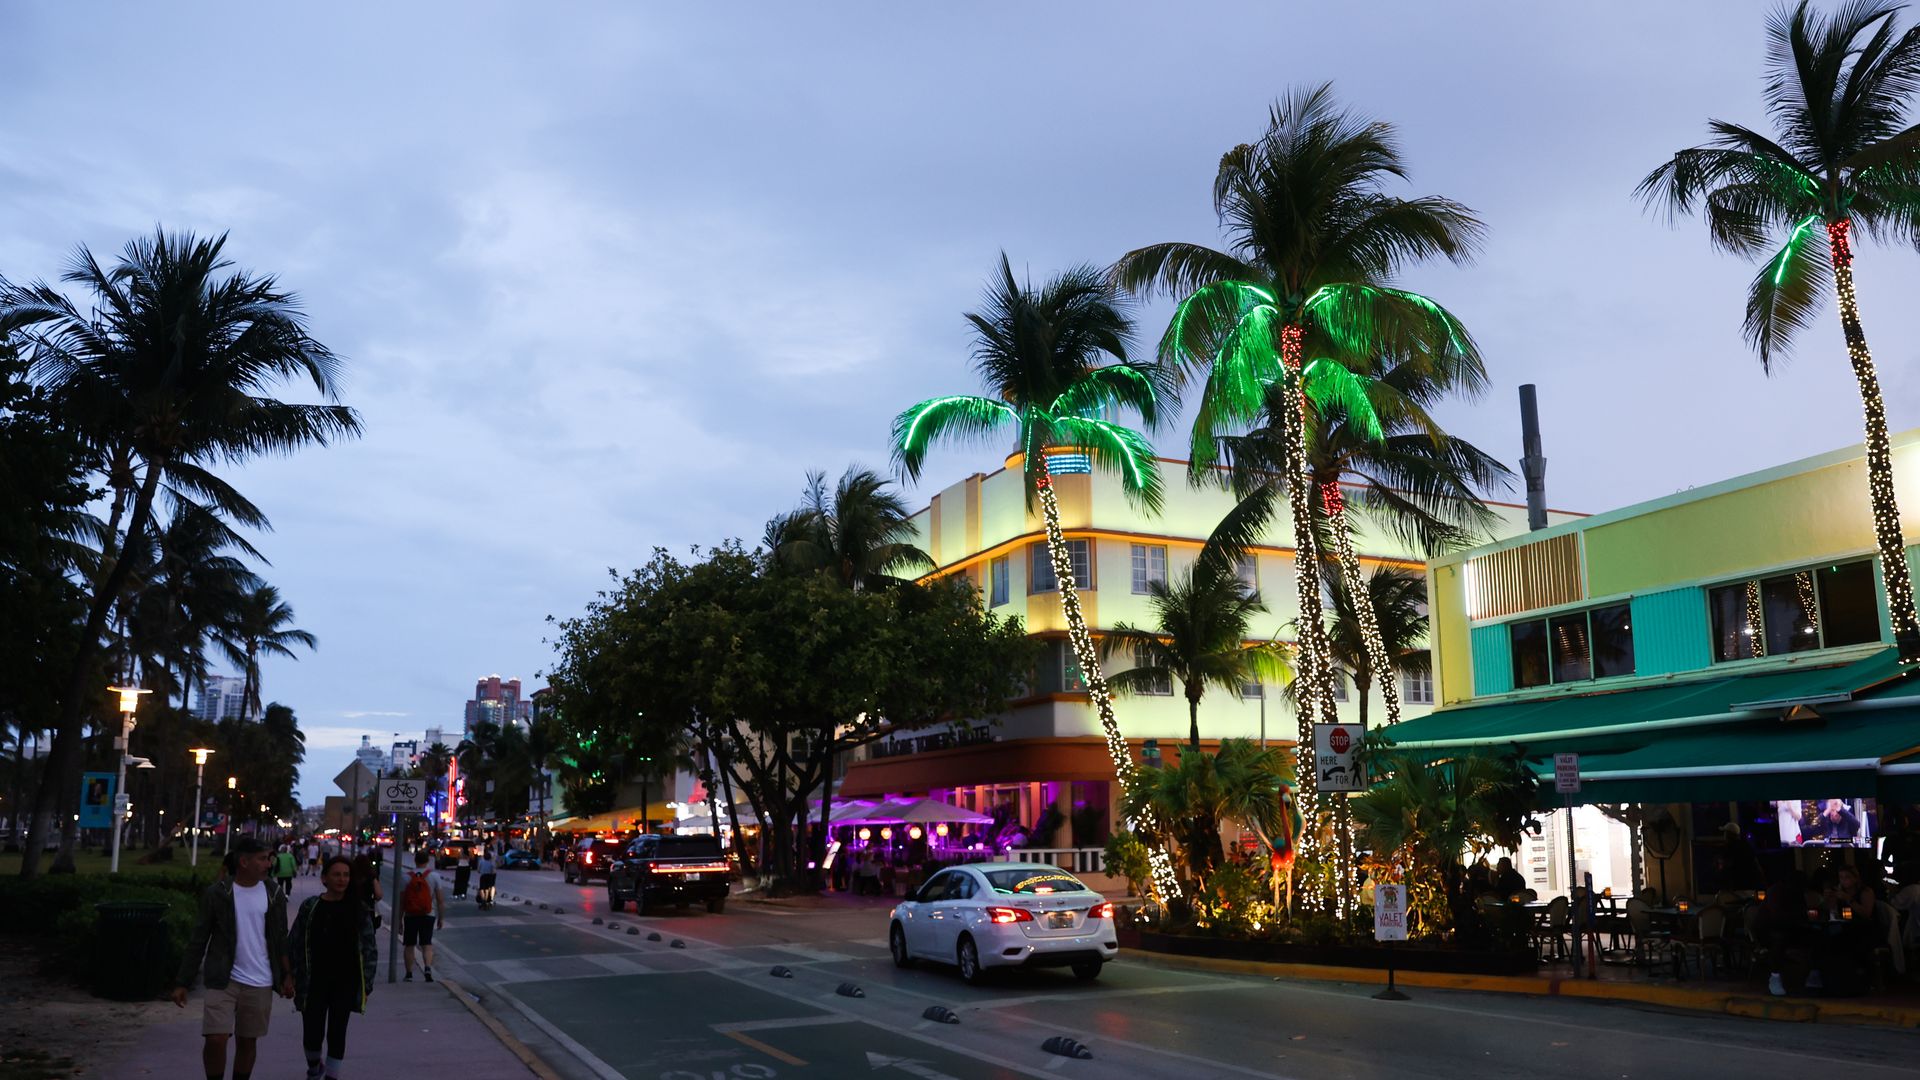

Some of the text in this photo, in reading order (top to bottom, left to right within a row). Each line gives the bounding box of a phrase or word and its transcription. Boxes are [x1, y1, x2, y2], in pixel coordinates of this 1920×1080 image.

[1330, 735, 1349, 746] STOP
[1320, 756, 1338, 765] HERE
[1335, 775, 1349, 784] FOR
[1379, 912, 1403, 922] VALET
